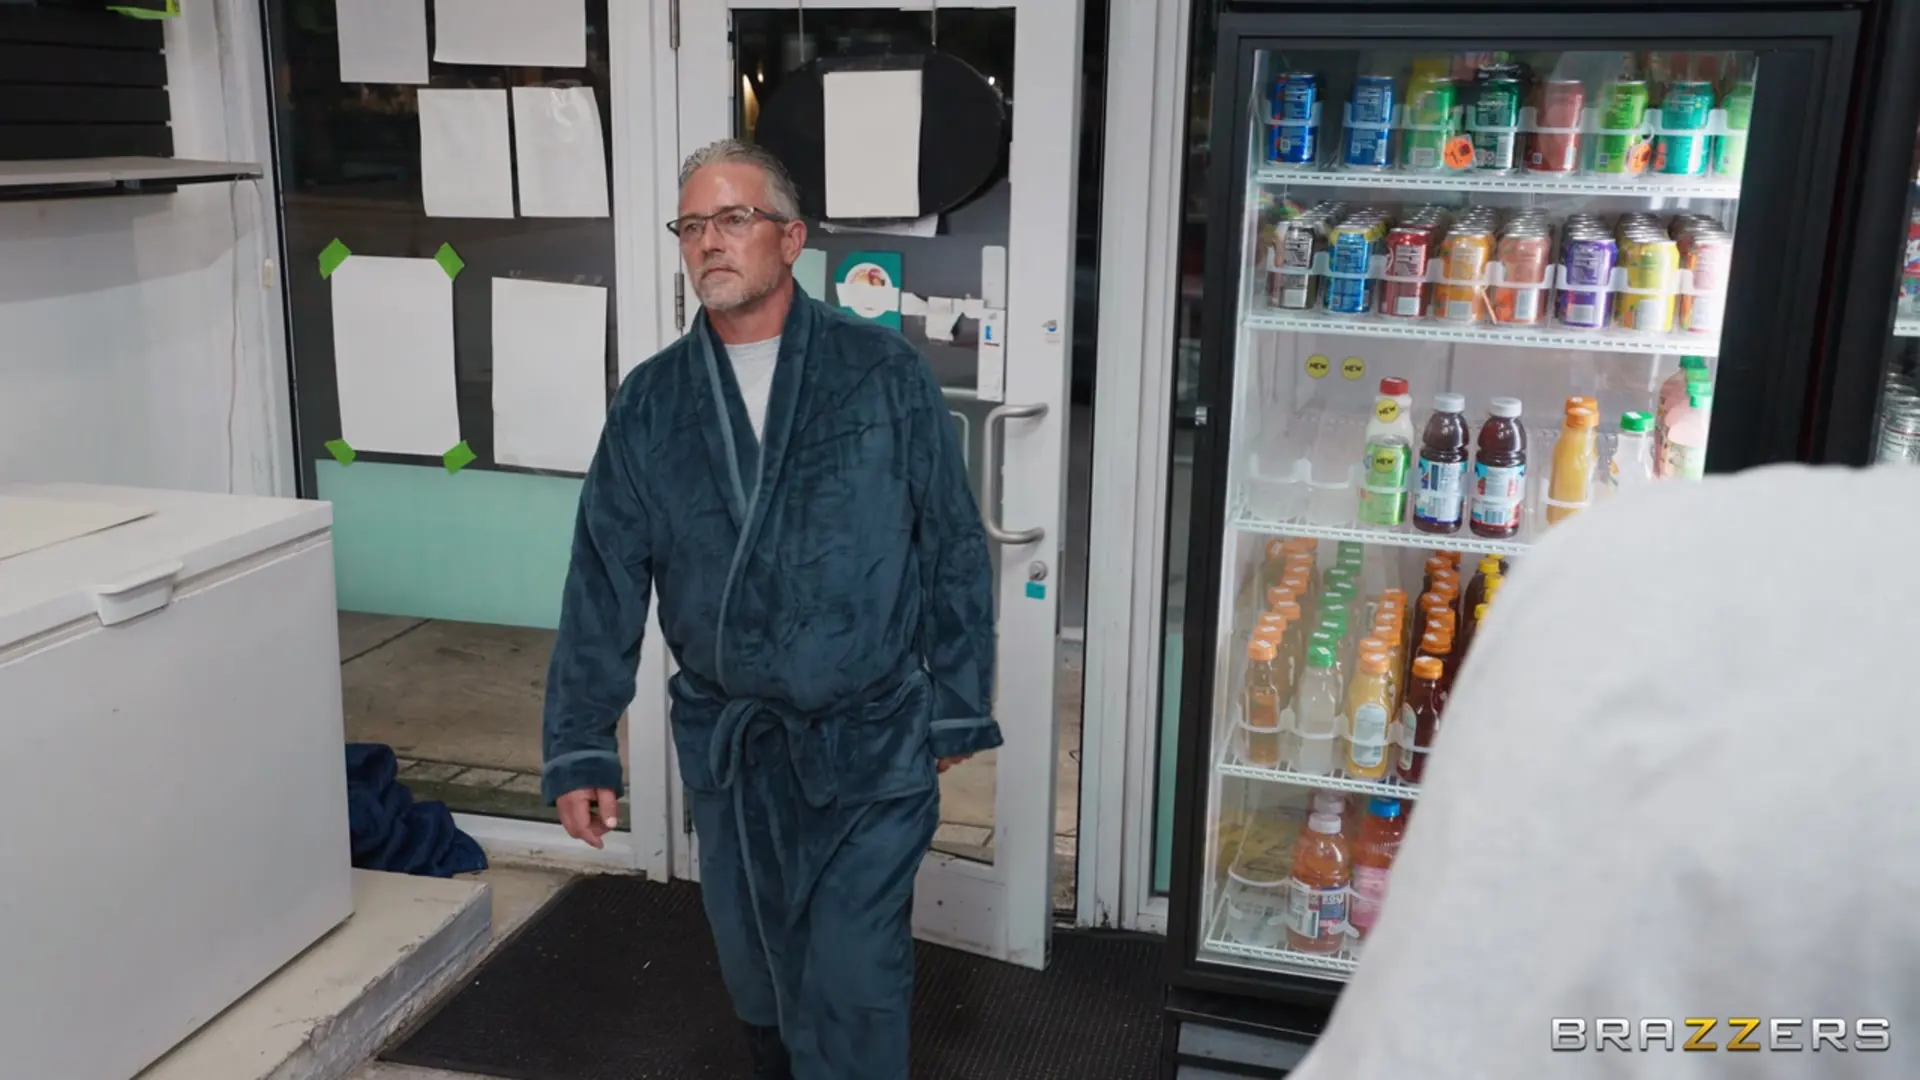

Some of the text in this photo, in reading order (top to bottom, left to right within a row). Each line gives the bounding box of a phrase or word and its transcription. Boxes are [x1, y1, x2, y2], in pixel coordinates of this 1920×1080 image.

[1309, 362, 1328, 370] NEW
[1344, 364, 1362, 372] NEW
[1379, 406, 1396, 415] NEW
[1376, 457, 1394, 465] NEW
